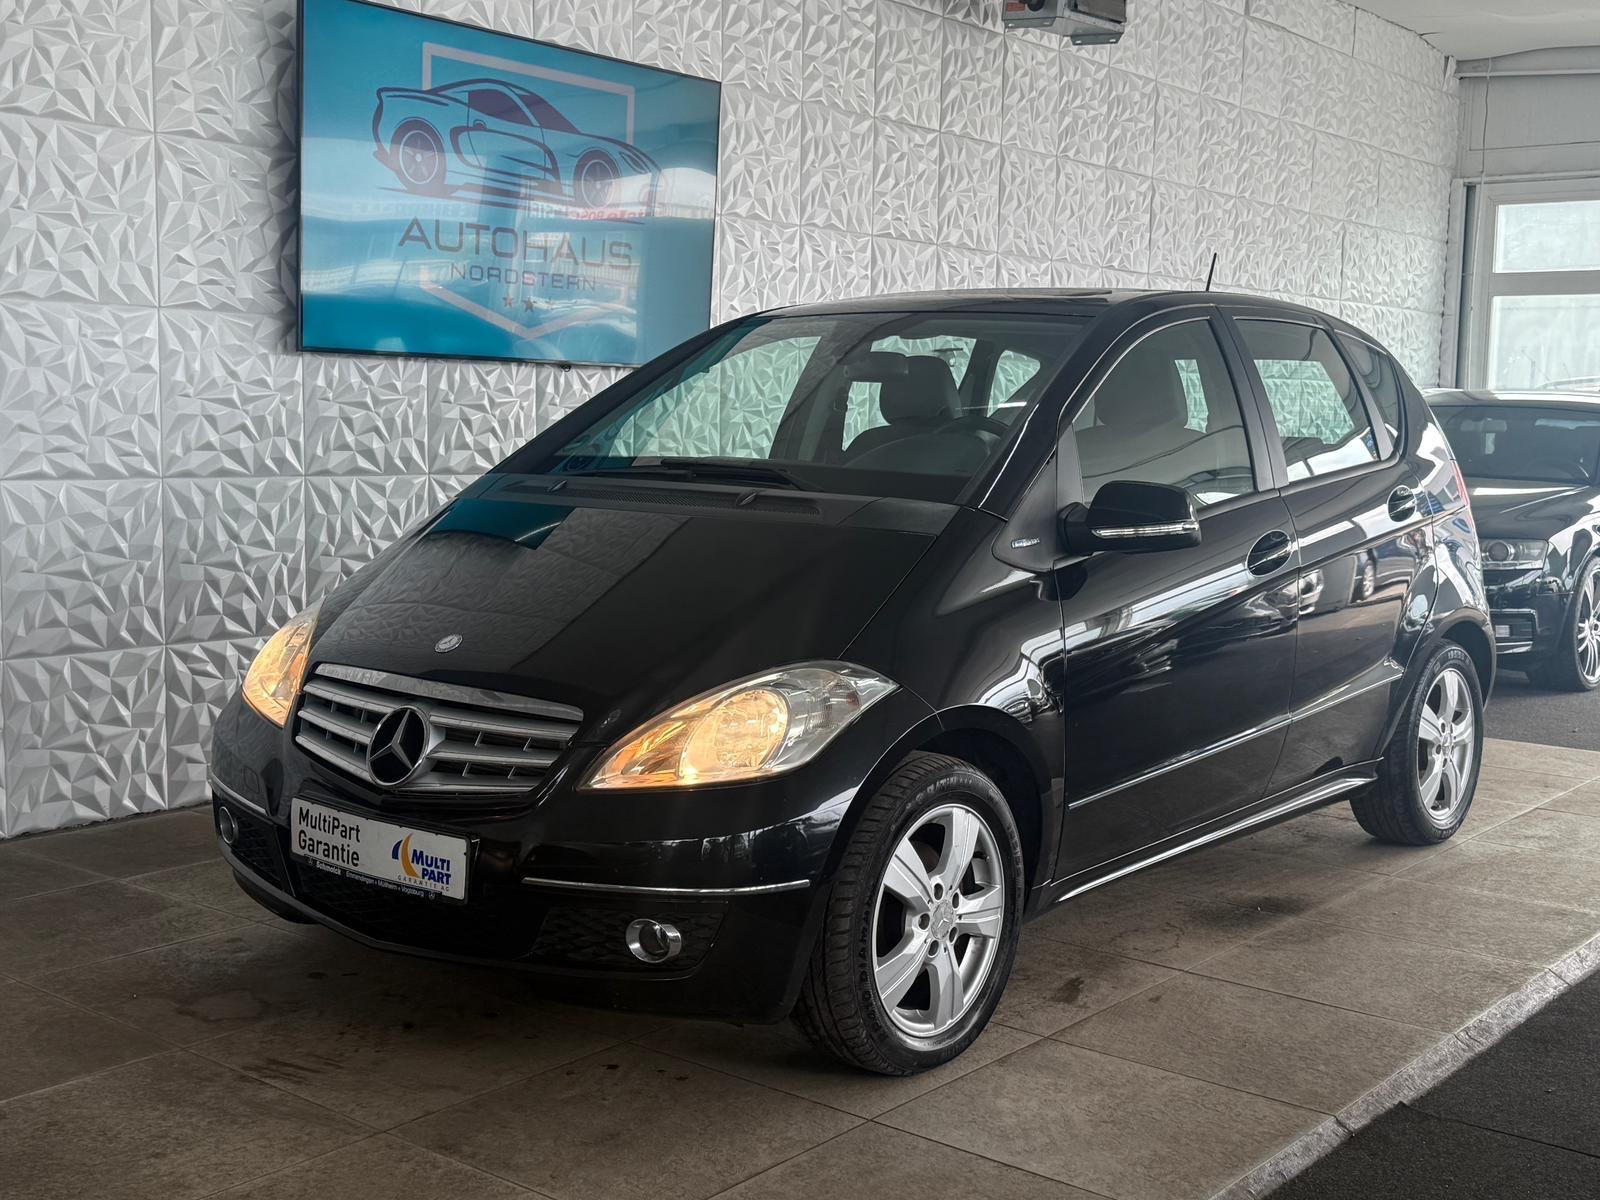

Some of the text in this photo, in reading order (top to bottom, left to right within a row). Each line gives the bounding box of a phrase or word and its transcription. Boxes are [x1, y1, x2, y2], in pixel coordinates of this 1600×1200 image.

[398, 216, 633, 269] AUTOHAUS
[451, 262, 596, 291] NORDSTERN
[298, 807, 361, 843] MultiPart
[298, 830, 360, 867] Garantie
[411, 849, 451, 872] MULTI
[398, 875, 437, 889] GARANTIE
[422, 868, 452, 885] PART
